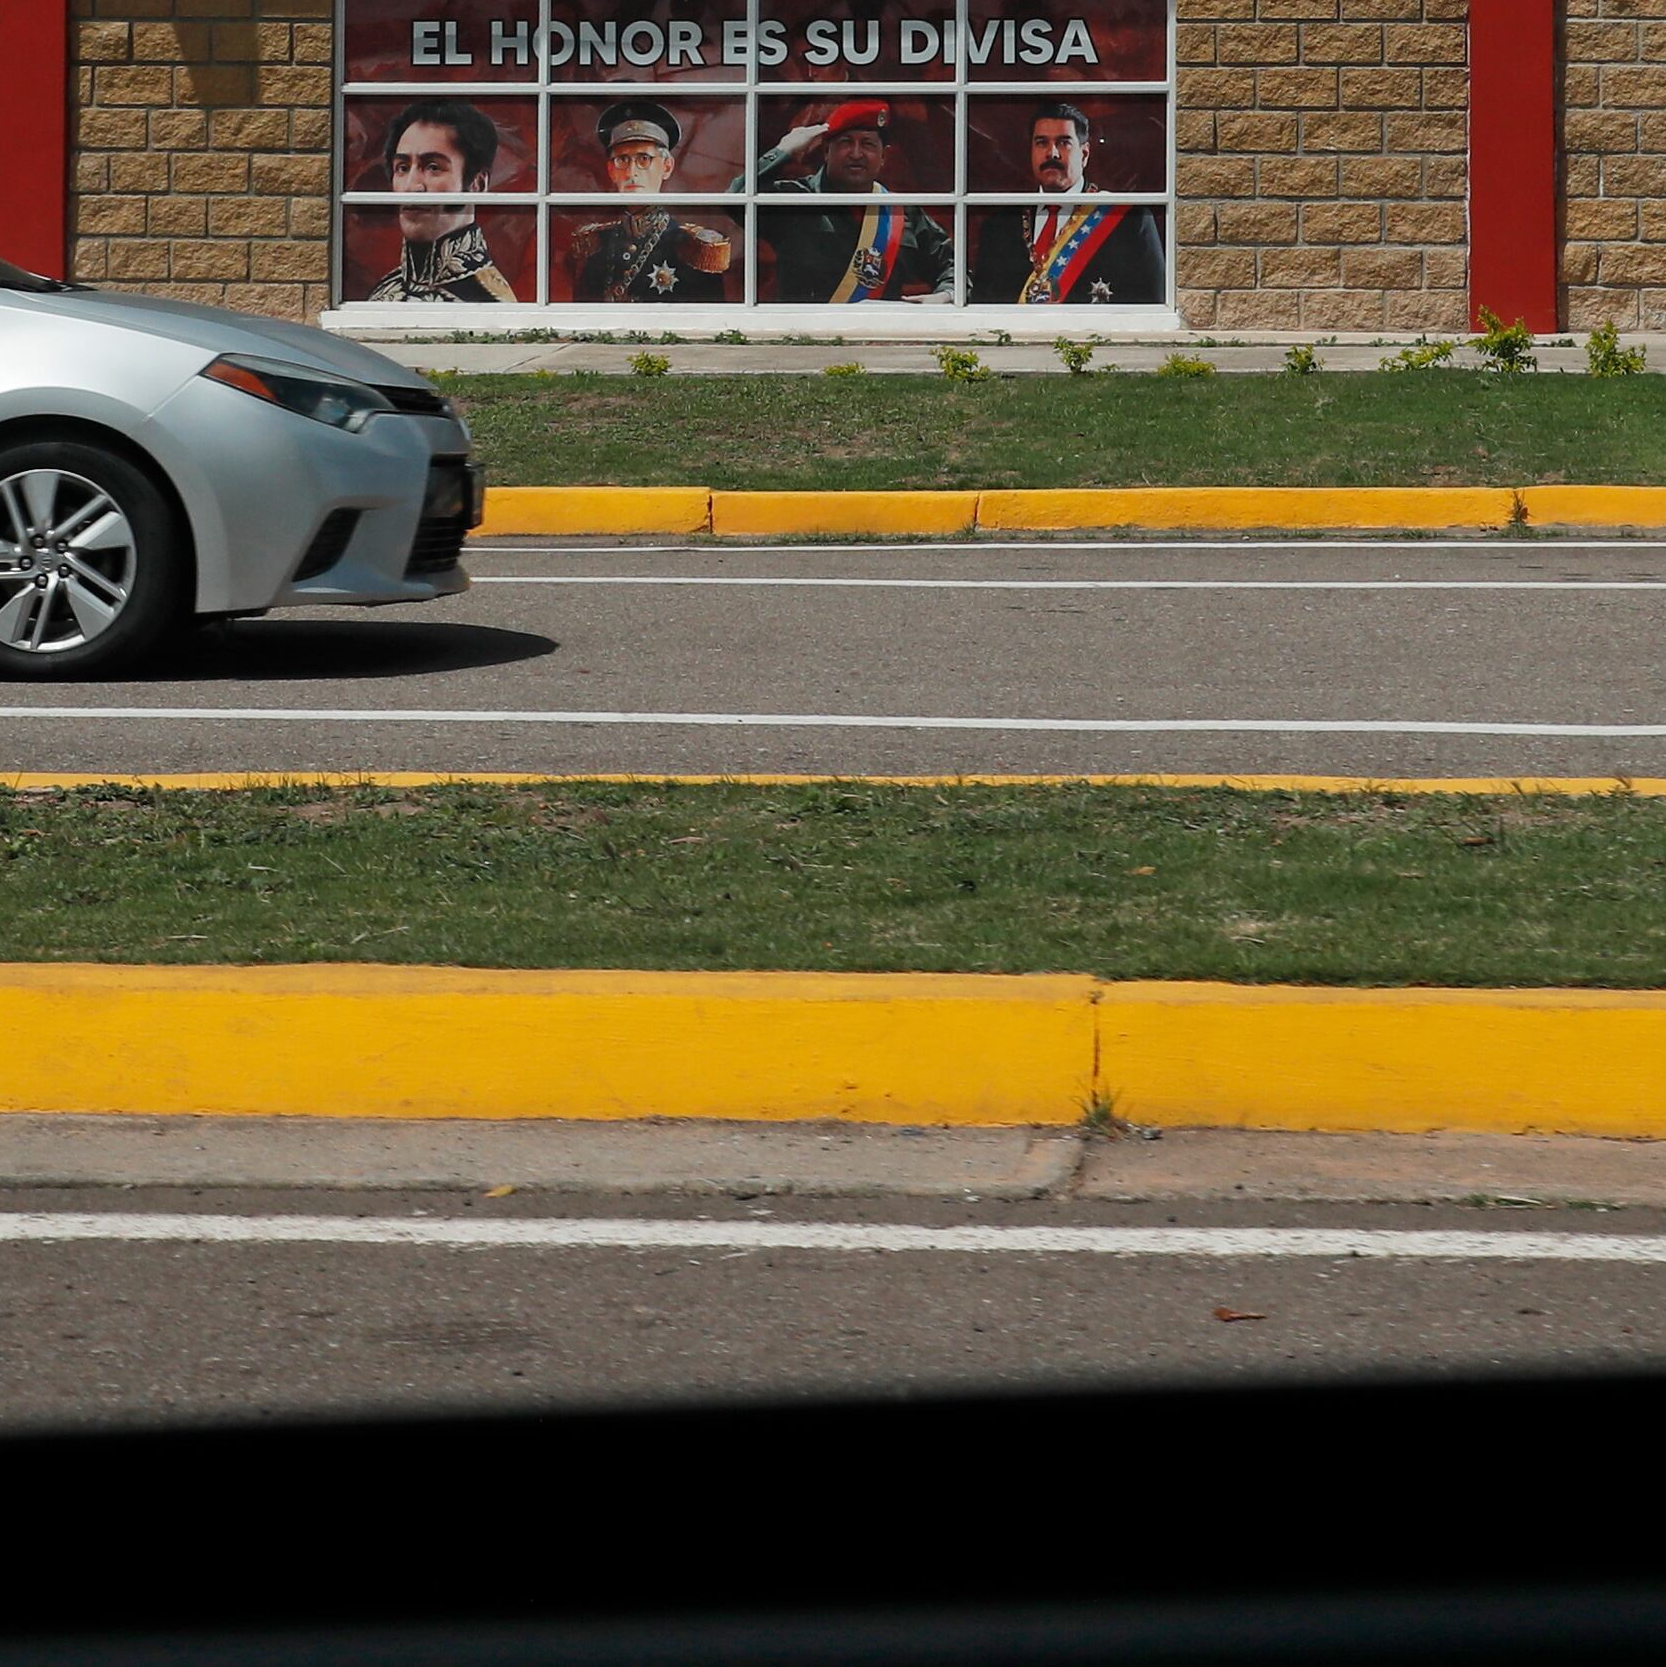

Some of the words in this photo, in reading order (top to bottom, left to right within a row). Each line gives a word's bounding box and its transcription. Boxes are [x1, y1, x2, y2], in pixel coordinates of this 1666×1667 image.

[412, 20, 472, 66] EL
[490, 19, 706, 67] HONOR
[722, 19, 789, 66] ES
[804, 19, 881, 66] SU
[899, 19, 1099, 65] DIVISA
